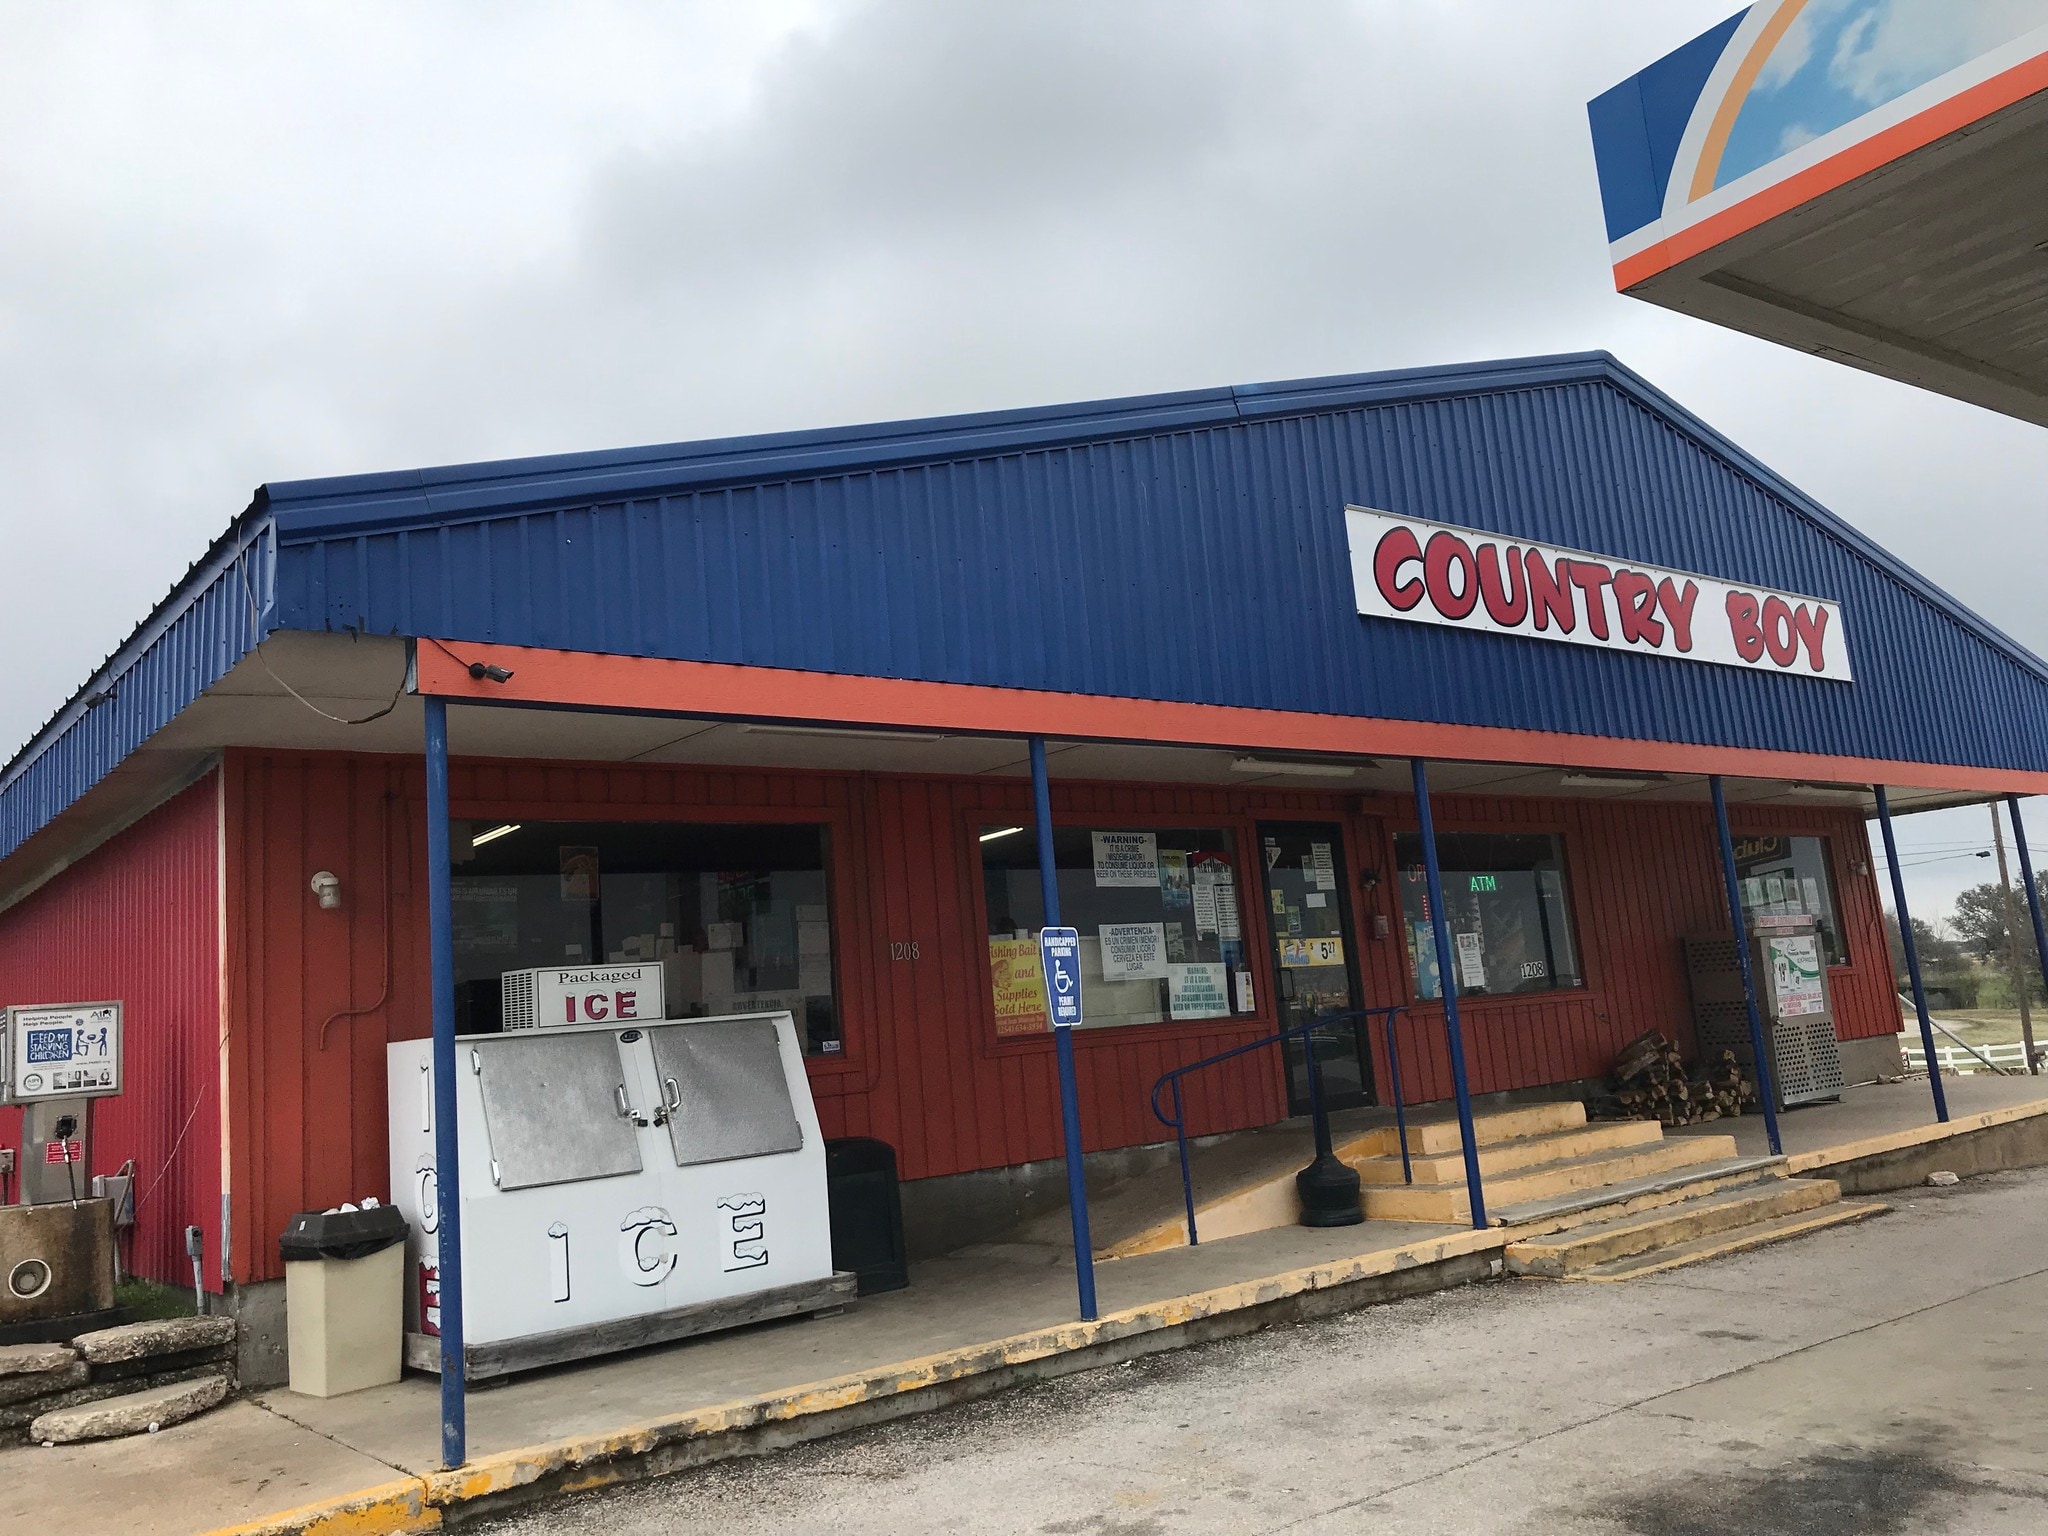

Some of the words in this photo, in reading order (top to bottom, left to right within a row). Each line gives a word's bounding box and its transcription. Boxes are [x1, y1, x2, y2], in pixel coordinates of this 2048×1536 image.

[1373, 526, 1700, 654] COUNTRY
[1725, 589, 1829, 673] BOY
[1105, 861, 1128, 869] CONSUME
[1129, 861, 1146, 869] LIQUOR
[1147, 861, 1155, 869] OR
[1117, 869, 1132, 878] THESE
[1471, 875, 1497, 892] ATM
[1044, 936, 1076, 947] HANDICAPPED
[1105, 937, 1112, 946] ES
[1112, 937, 1119, 945] UN
[1120, 936, 1138, 945] CRIMEN
[890, 942, 921, 962] 1208
[1018, 944, 1036, 956] Bait
[1051, 946, 1071, 957] PARKING
[1111, 945, 1136, 954] CONSUMIR
[1136, 944, 1151, 953] LICOR
[1113, 954, 1134, 963] CERVEZA
[1135, 953, 1142, 962] EN
[1143, 953, 1155, 961] ESTE
[1014, 966, 1035, 978] and
[1126, 962, 1144, 971] LUGAR
[1520, 962, 1545, 978] 1208
[557, 968, 642, 986] Packaged
[997, 988, 1038, 1002] Supplies
[1058, 995, 1074, 1005] PERMIT
[564, 988, 638, 1024] ICE
[994, 1003, 1014, 1015] Sold
[1018, 1002, 1041, 1014] Here
[1057, 1006, 1077, 1017] REQUIRED
[30, 1032, 55, 1044] FEED
[57, 1033, 68, 1041] MY
[30, 1041, 68, 1052] STARVING
[30, 1050, 68, 1060] CHILDREN
[547, 1191, 770, 1304] ICE
